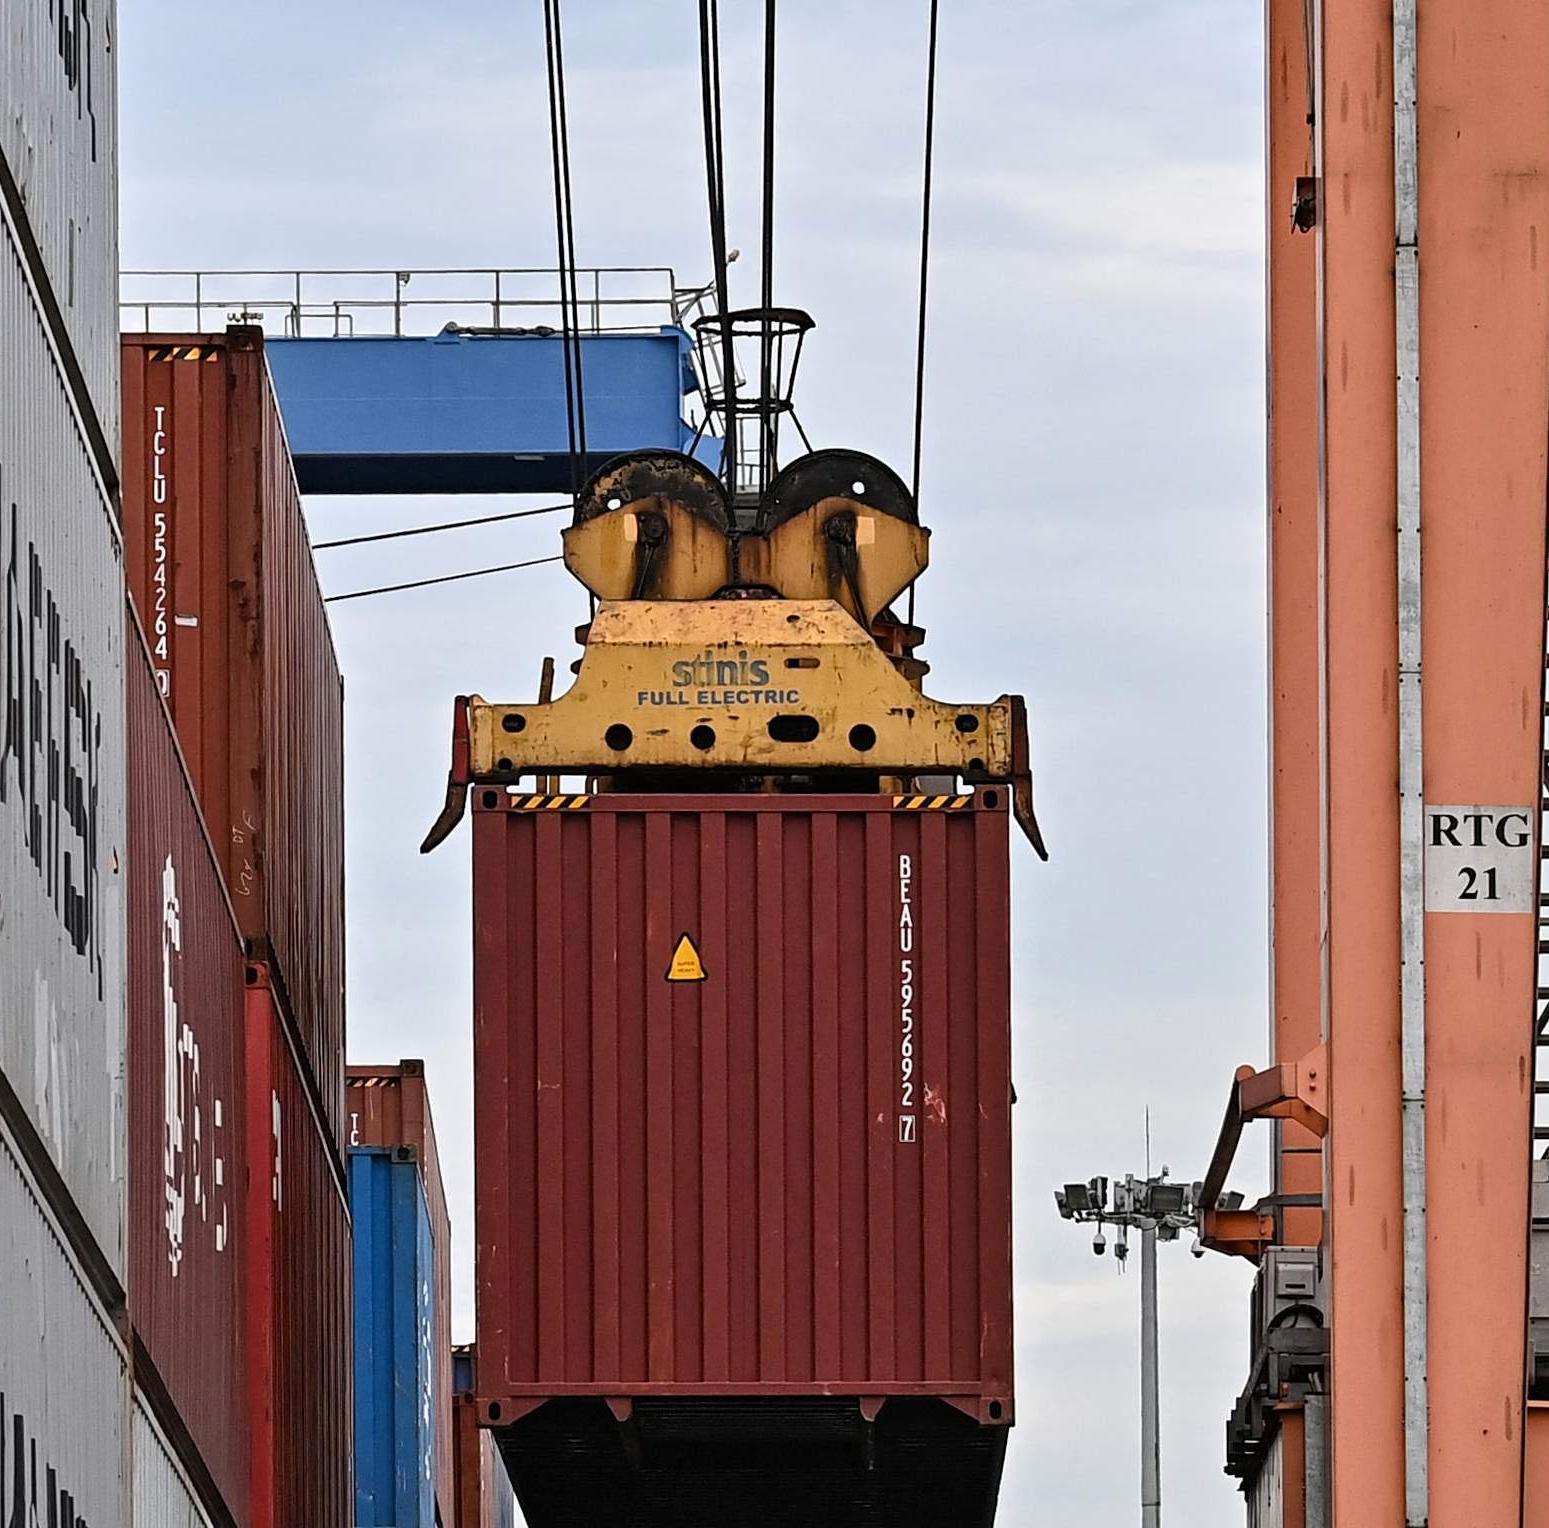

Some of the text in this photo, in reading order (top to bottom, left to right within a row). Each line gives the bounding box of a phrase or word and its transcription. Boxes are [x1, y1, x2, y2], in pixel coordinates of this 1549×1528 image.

[153, 406, 166, 503] TCLU
[154, 513, 167, 660] 554264
[638, 690, 800, 705] FULL ELECTRIC
[672, 650, 770, 687] stinis
[1429, 813, 1530, 848] RTG
[899, 854, 913, 952] BEAU
[1458, 867, 1500, 900] 21
[901, 959, 913, 1106] 595692
